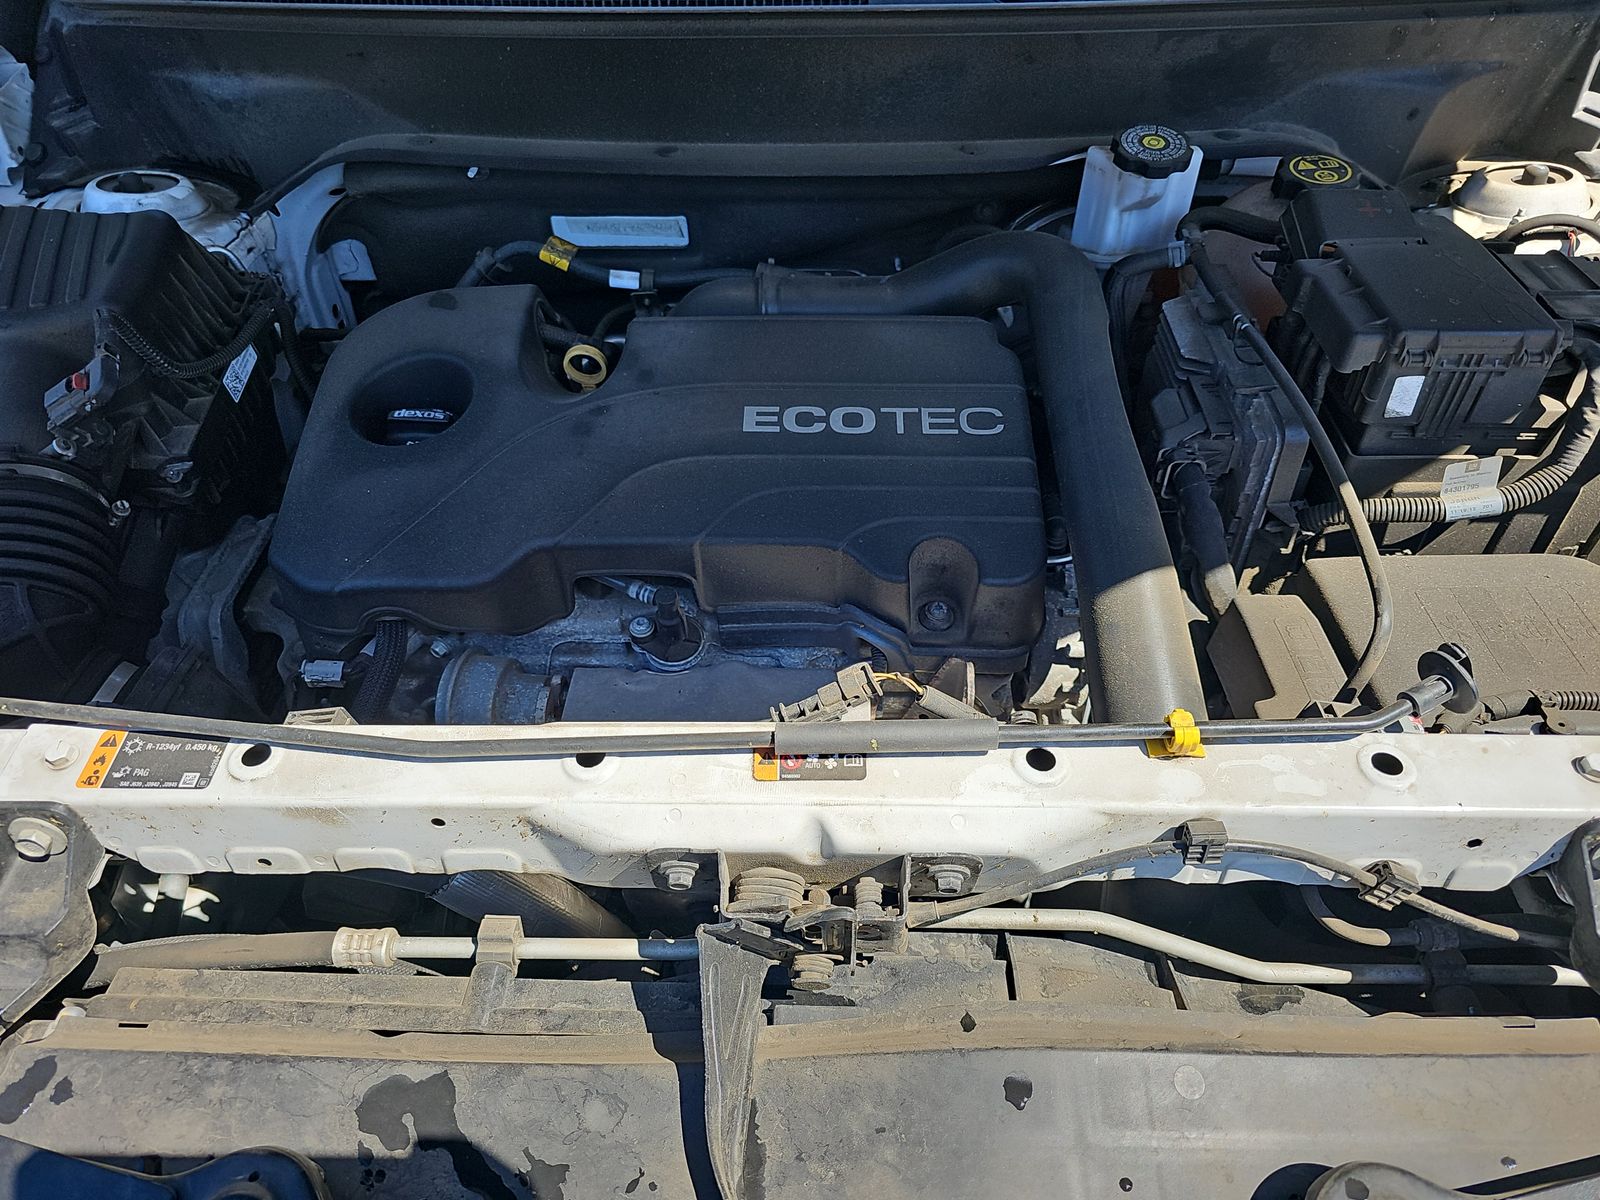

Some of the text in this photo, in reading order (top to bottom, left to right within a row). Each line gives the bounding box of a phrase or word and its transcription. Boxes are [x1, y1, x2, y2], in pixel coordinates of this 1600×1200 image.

[393, 409, 444, 420] dexos
[743, 406, 1004, 435] ECOTEC
[146, 743, 181, 752] R-1234yf
[185, 743, 207, 751] 0.450
[132, 768, 150, 776] PAG
